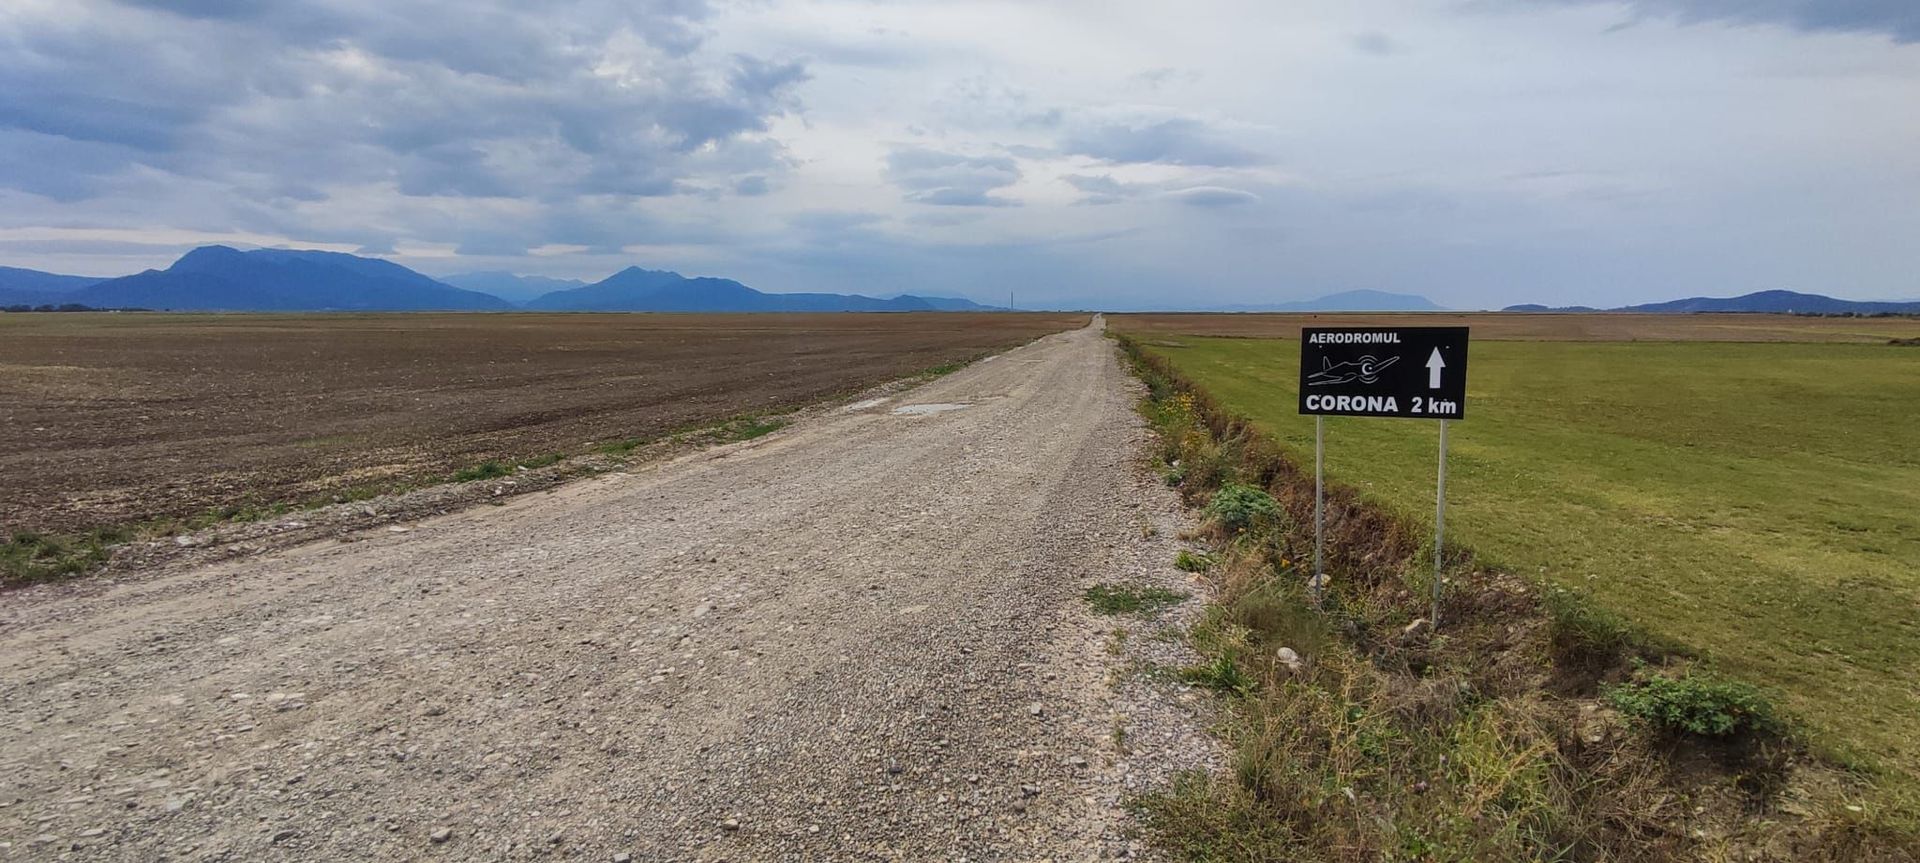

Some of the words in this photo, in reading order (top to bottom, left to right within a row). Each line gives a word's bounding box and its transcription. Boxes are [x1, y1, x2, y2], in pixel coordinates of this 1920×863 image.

[1309, 333, 1401, 344] AERODROMUL
[1306, 395, 1398, 412] CORONA
[1411, 397, 1423, 413] 2
[1428, 398, 1457, 414] km
